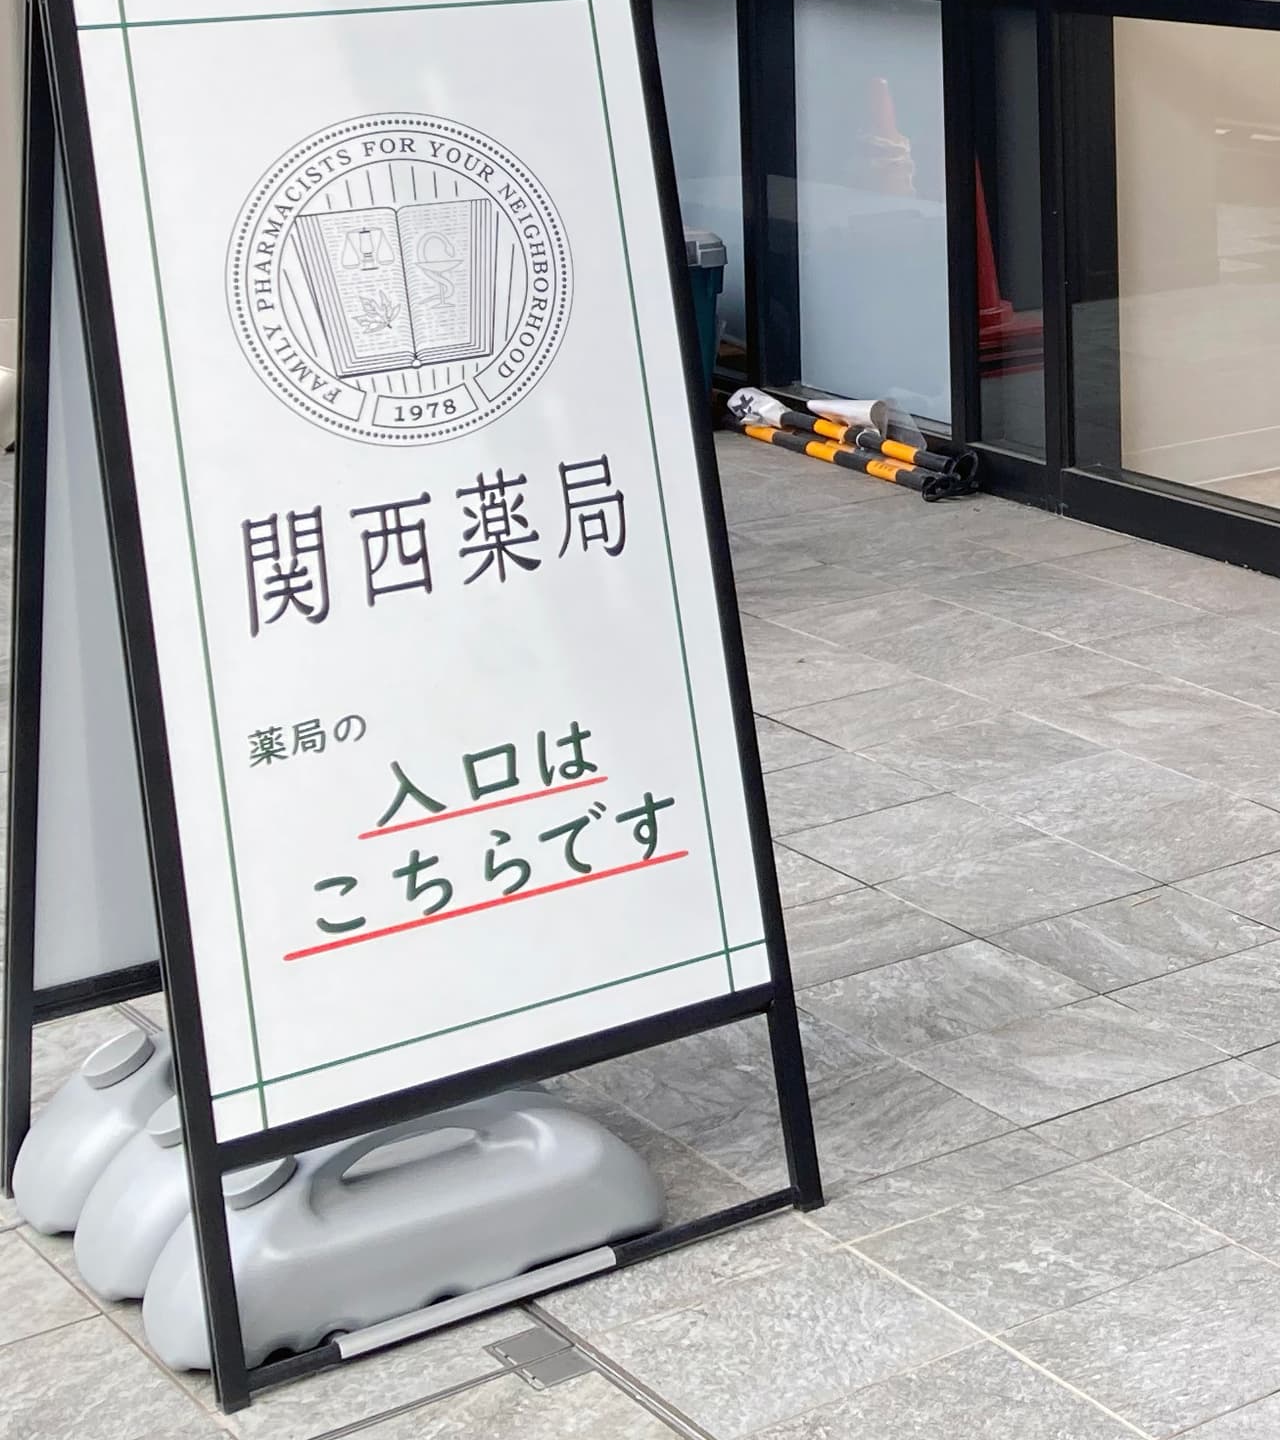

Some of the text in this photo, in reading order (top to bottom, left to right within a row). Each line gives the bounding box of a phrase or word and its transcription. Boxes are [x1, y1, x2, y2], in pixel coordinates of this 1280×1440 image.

[253, 137, 550, 404] FAMILY PHARMACISTS FOR YOUR NEIGHBORHOOD
[394, 398, 457, 422] 1978
[241, 453, 626, 637] 関西薬局
[248, 713, 367, 768] 薬局の
[377, 721, 598, 827] 入口は
[314, 791, 675, 933] こちらです
